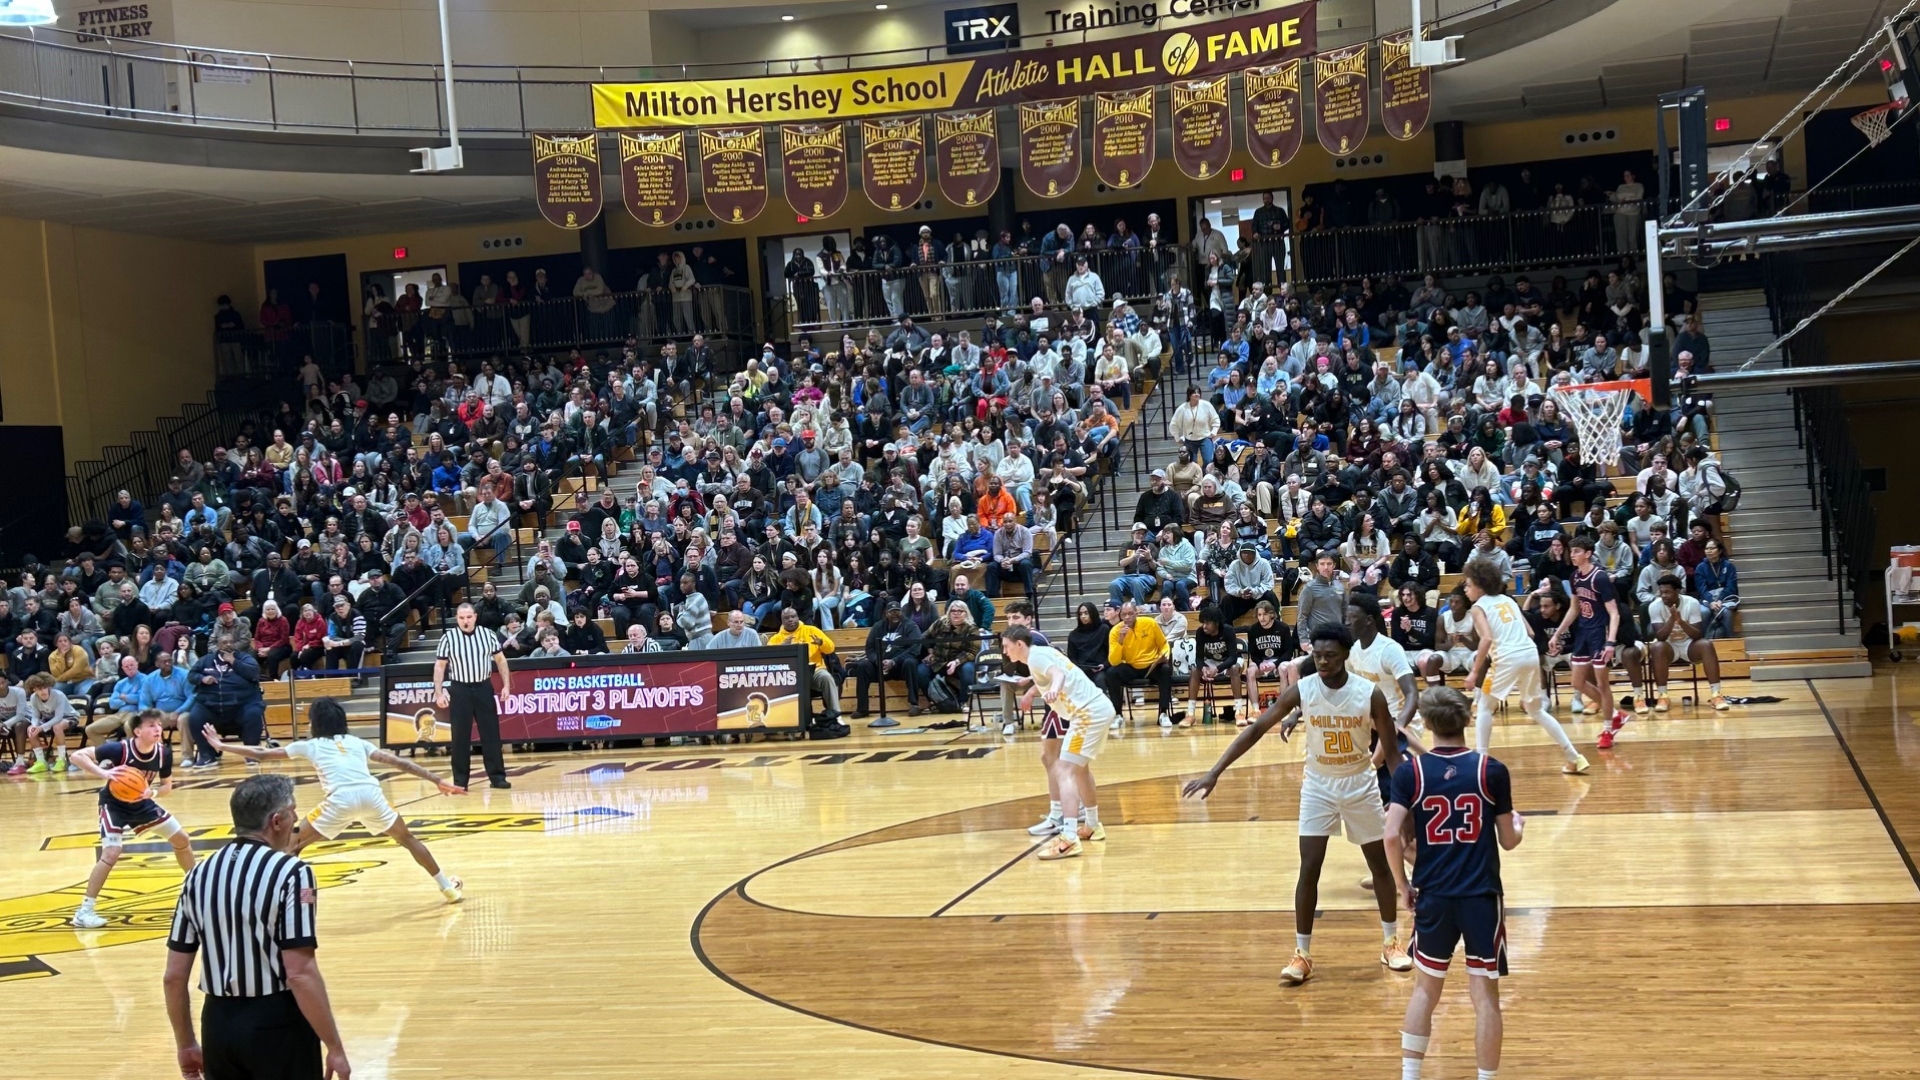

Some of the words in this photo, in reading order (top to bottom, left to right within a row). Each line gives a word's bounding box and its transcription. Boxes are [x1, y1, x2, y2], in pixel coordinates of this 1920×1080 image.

[78, 4, 149, 26] FITNESS
[1045, 1, 1157, 31] Training
[76, 21, 153, 43] GALLERY
[952, 16, 1012, 41] TRX
[976, 59, 1049, 103] Athletic
[1057, 48, 1156, 86] HALL
[1206, 18, 1302, 63] FAME
[1317, 62, 1337, 83] HALL
[1345, 51, 1366, 72] FAME
[1247, 76, 1267, 96] HALL
[1275, 67, 1298, 88] FAME
[1333, 75, 1350, 86] 2013
[625, 91, 717, 118] Milton
[727, 83, 842, 115] Hershey
[852, 71, 947, 107] School
[1174, 90, 1195, 110] HALL
[1203, 81, 1227, 102] FAME
[1264, 89, 1282, 100] 2012
[1022, 109, 1045, 129] HALL
[1054, 103, 1078, 122] FAME
[1097, 100, 1119, 119] HALL
[1128, 94, 1152, 113] FAME
[1192, 103, 1208, 114] 2011
[937, 121, 960, 139] HALL
[970, 114, 994, 133] FAME
[1114, 114, 1133, 124] 2010
[702, 136, 726, 155] HALL
[736, 133, 762, 152] FAME
[784, 132, 808, 151] HALL
[818, 128, 843, 147] FAME
[864, 126, 888, 145] HALL
[897, 122, 922, 141] FAME
[535, 139, 561, 158] HALL
[571, 137, 596, 157] FAME
[622, 138, 647, 157] HALL
[657, 136, 682, 156] FAME
[883, 141, 904, 150] 2007
[556, 157, 577, 165] 2004
[642, 155, 664, 163] 2004
[1494, 603, 1518, 624] 21
[1256, 635, 1281, 643] MILTON
[534, 677, 567, 691] BOYS
[569, 673, 645, 689] BASKETBALL
[719, 671, 797, 689] SPARTANS
[505, 691, 591, 714] DISTRICT
[592, 690, 606, 710] 3
[609, 685, 703, 710] PLAYOFFS
[1310, 715, 1364, 729] MILTON
[1323, 731, 1354, 754] 20
[1421, 793, 1483, 845] 23
